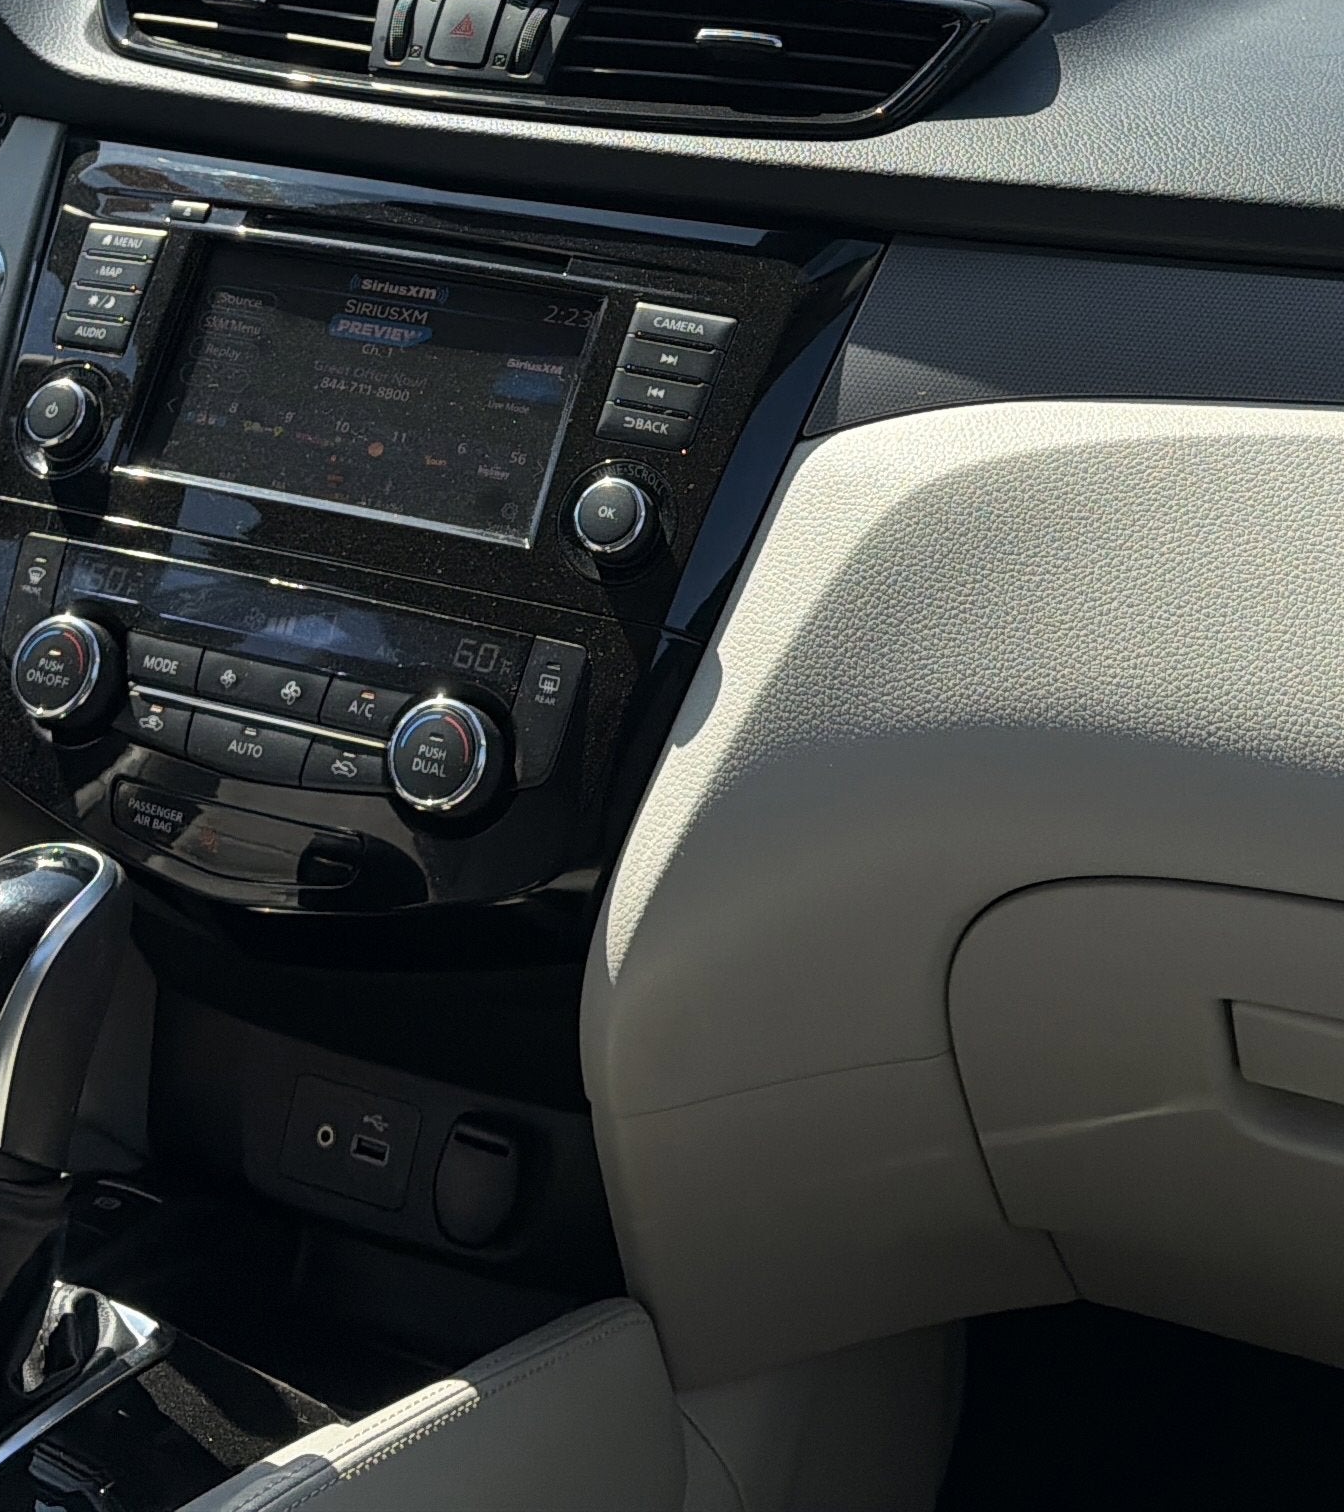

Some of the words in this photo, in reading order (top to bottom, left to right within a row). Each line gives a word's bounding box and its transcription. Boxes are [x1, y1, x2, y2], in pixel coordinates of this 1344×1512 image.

[112, 236, 143, 249] MENU
[99, 265, 123, 278] MAP
[222, 291, 264, 308] Source
[344, 299, 429, 325] SIRIUSXM
[543, 304, 594, 329] 2:23
[74, 325, 107, 339] AUDIO
[337, 319, 422, 341] PREVIEW
[653, 316, 705, 335] CAMERA
[204, 343, 242, 361] Replay
[335, 420, 351, 433] 10
[635, 418, 670, 435] BACK
[597, 505, 617, 520] OK
[453, 637, 502, 673] 60
[38, 657, 65, 672] PUSH
[142, 654, 179, 675] MODE
[347, 700, 375, 719] A/C
[534, 695, 556, 706] REAR
[227, 739, 263, 758] AUTO
[417, 743, 448, 761] PUSH
[411, 757, 448, 778] DUAL
[127, 797, 184, 823] PASSENGER
[133, 813, 151, 828] AIR
[151, 818, 173, 834] BAG
